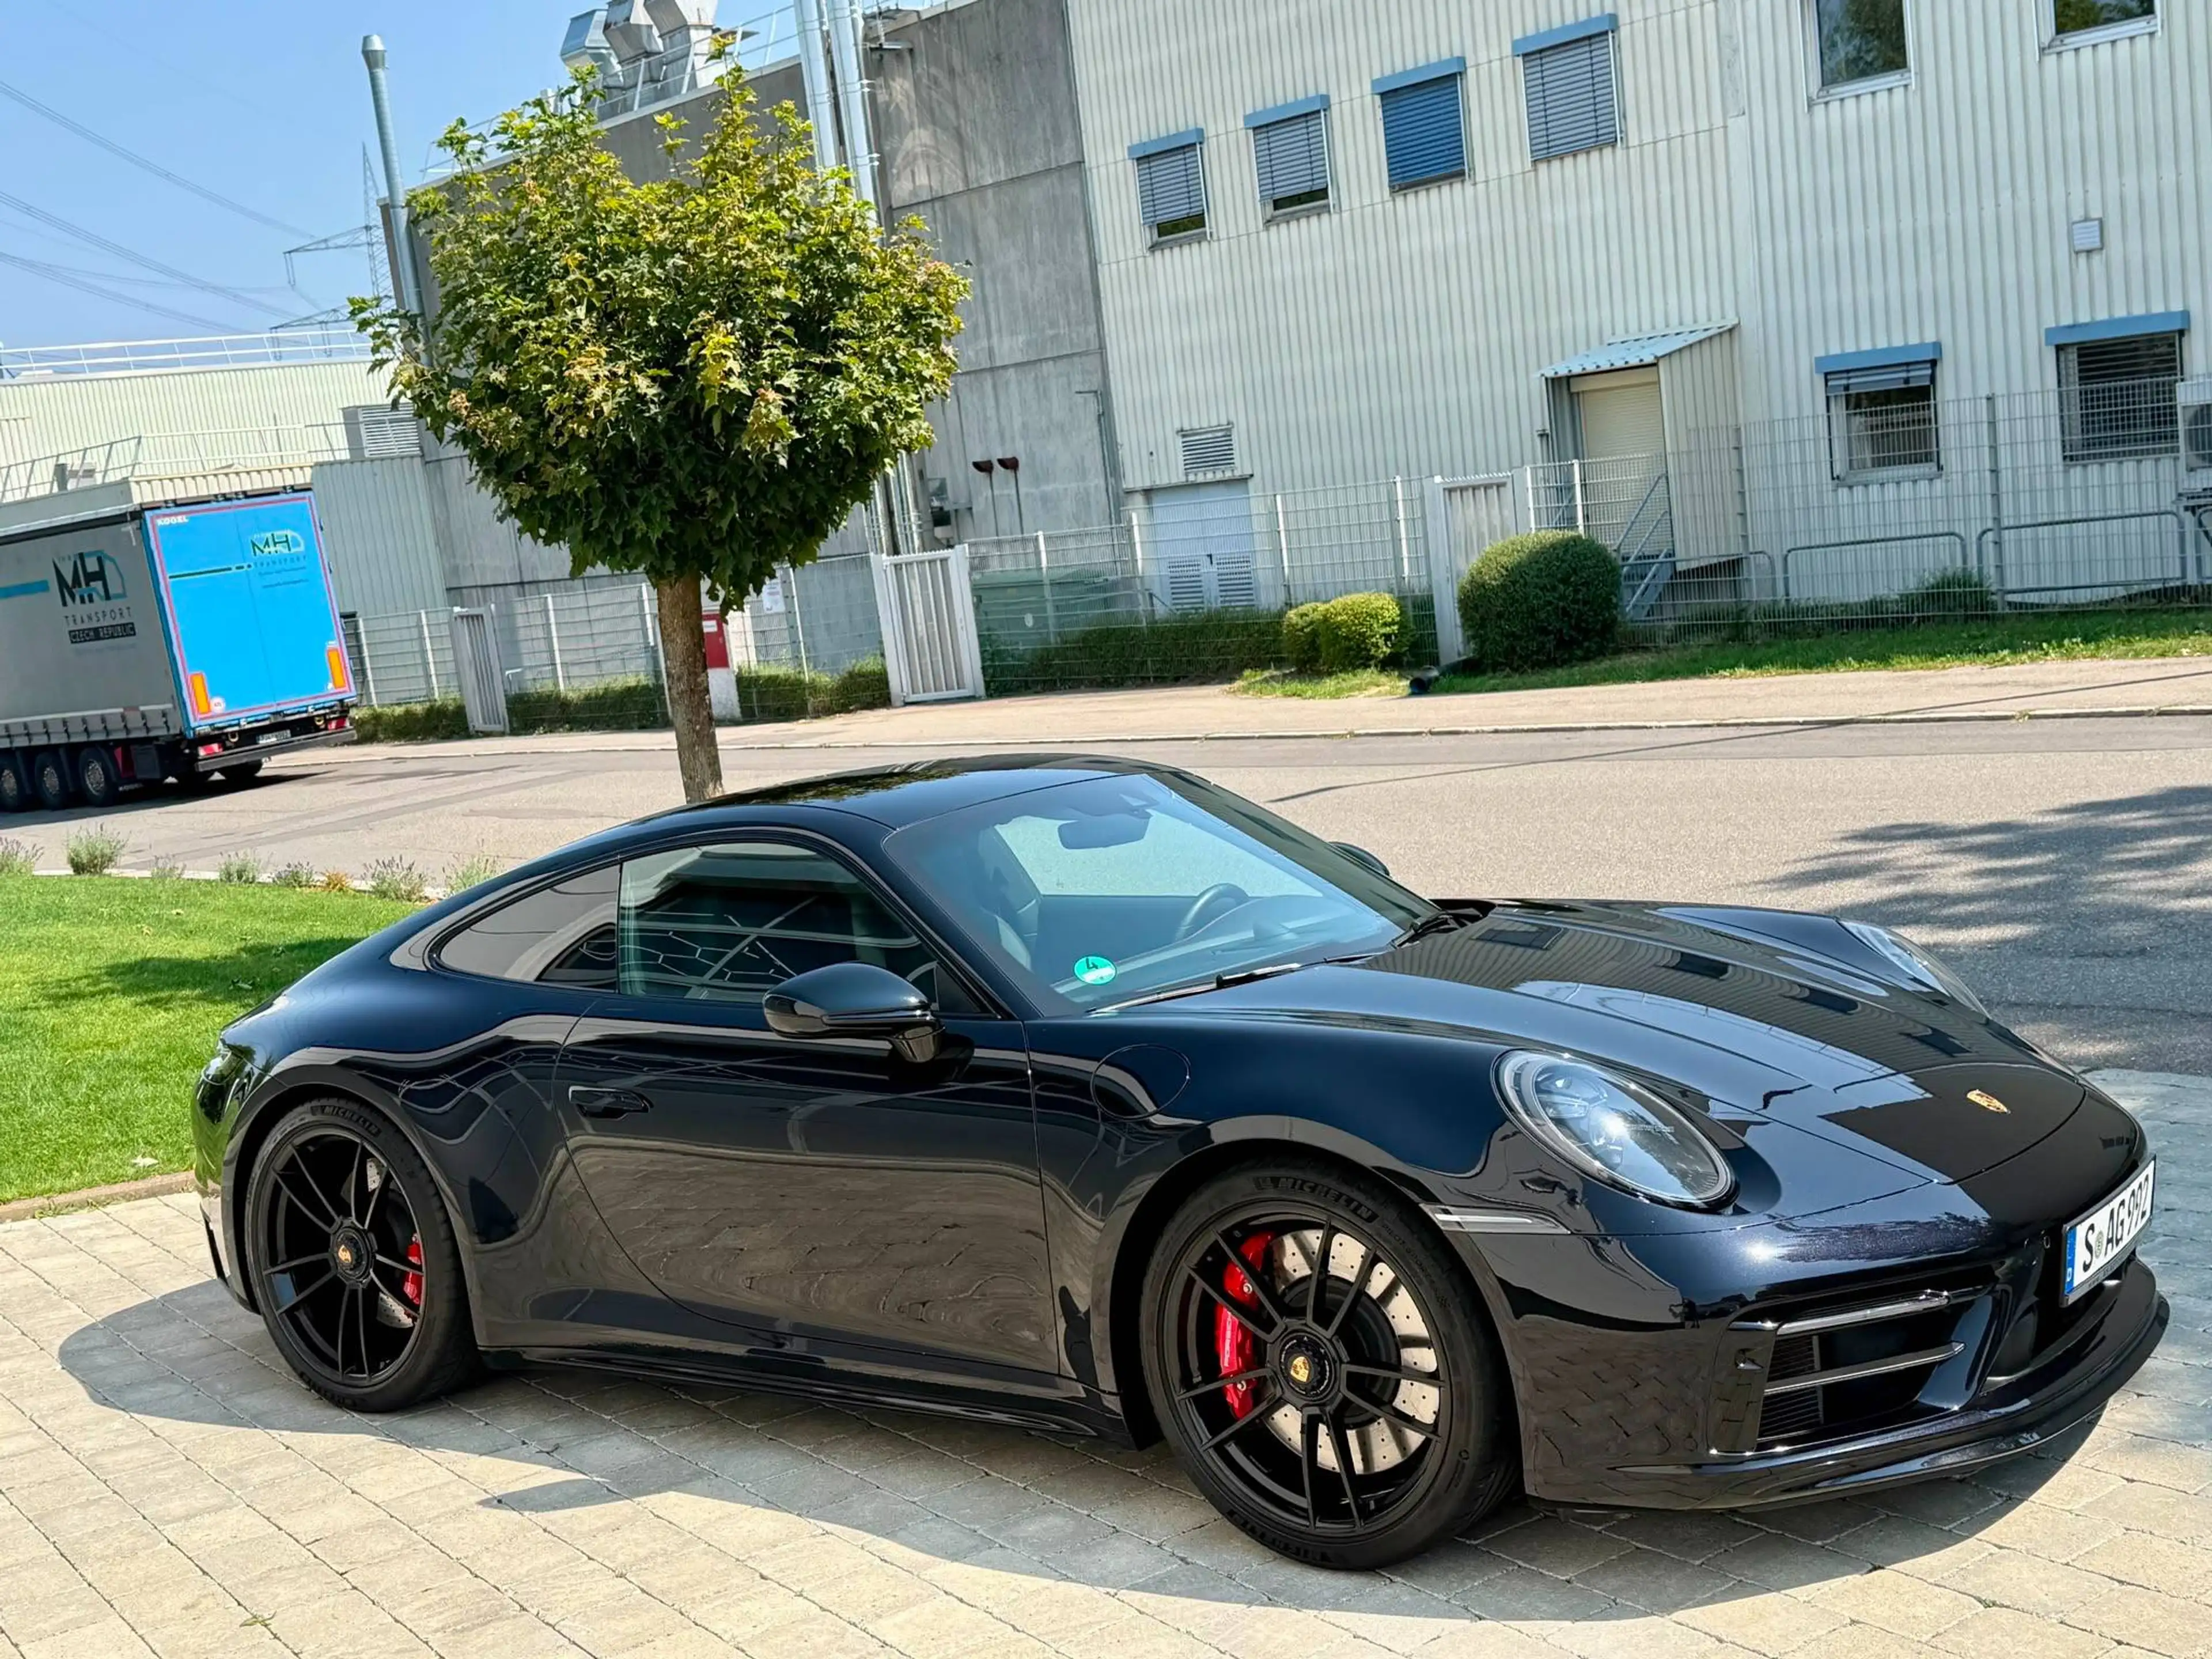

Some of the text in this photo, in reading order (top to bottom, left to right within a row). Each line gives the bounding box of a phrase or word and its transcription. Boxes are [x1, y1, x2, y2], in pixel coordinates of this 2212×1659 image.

[63, 607, 131, 626] TRANSPORT
[70, 624, 135, 642] CZECH REPUBLIC
[1279, 1177, 1372, 1220] MICHELIN
[2082, 1173, 2150, 1273] S AG 992
